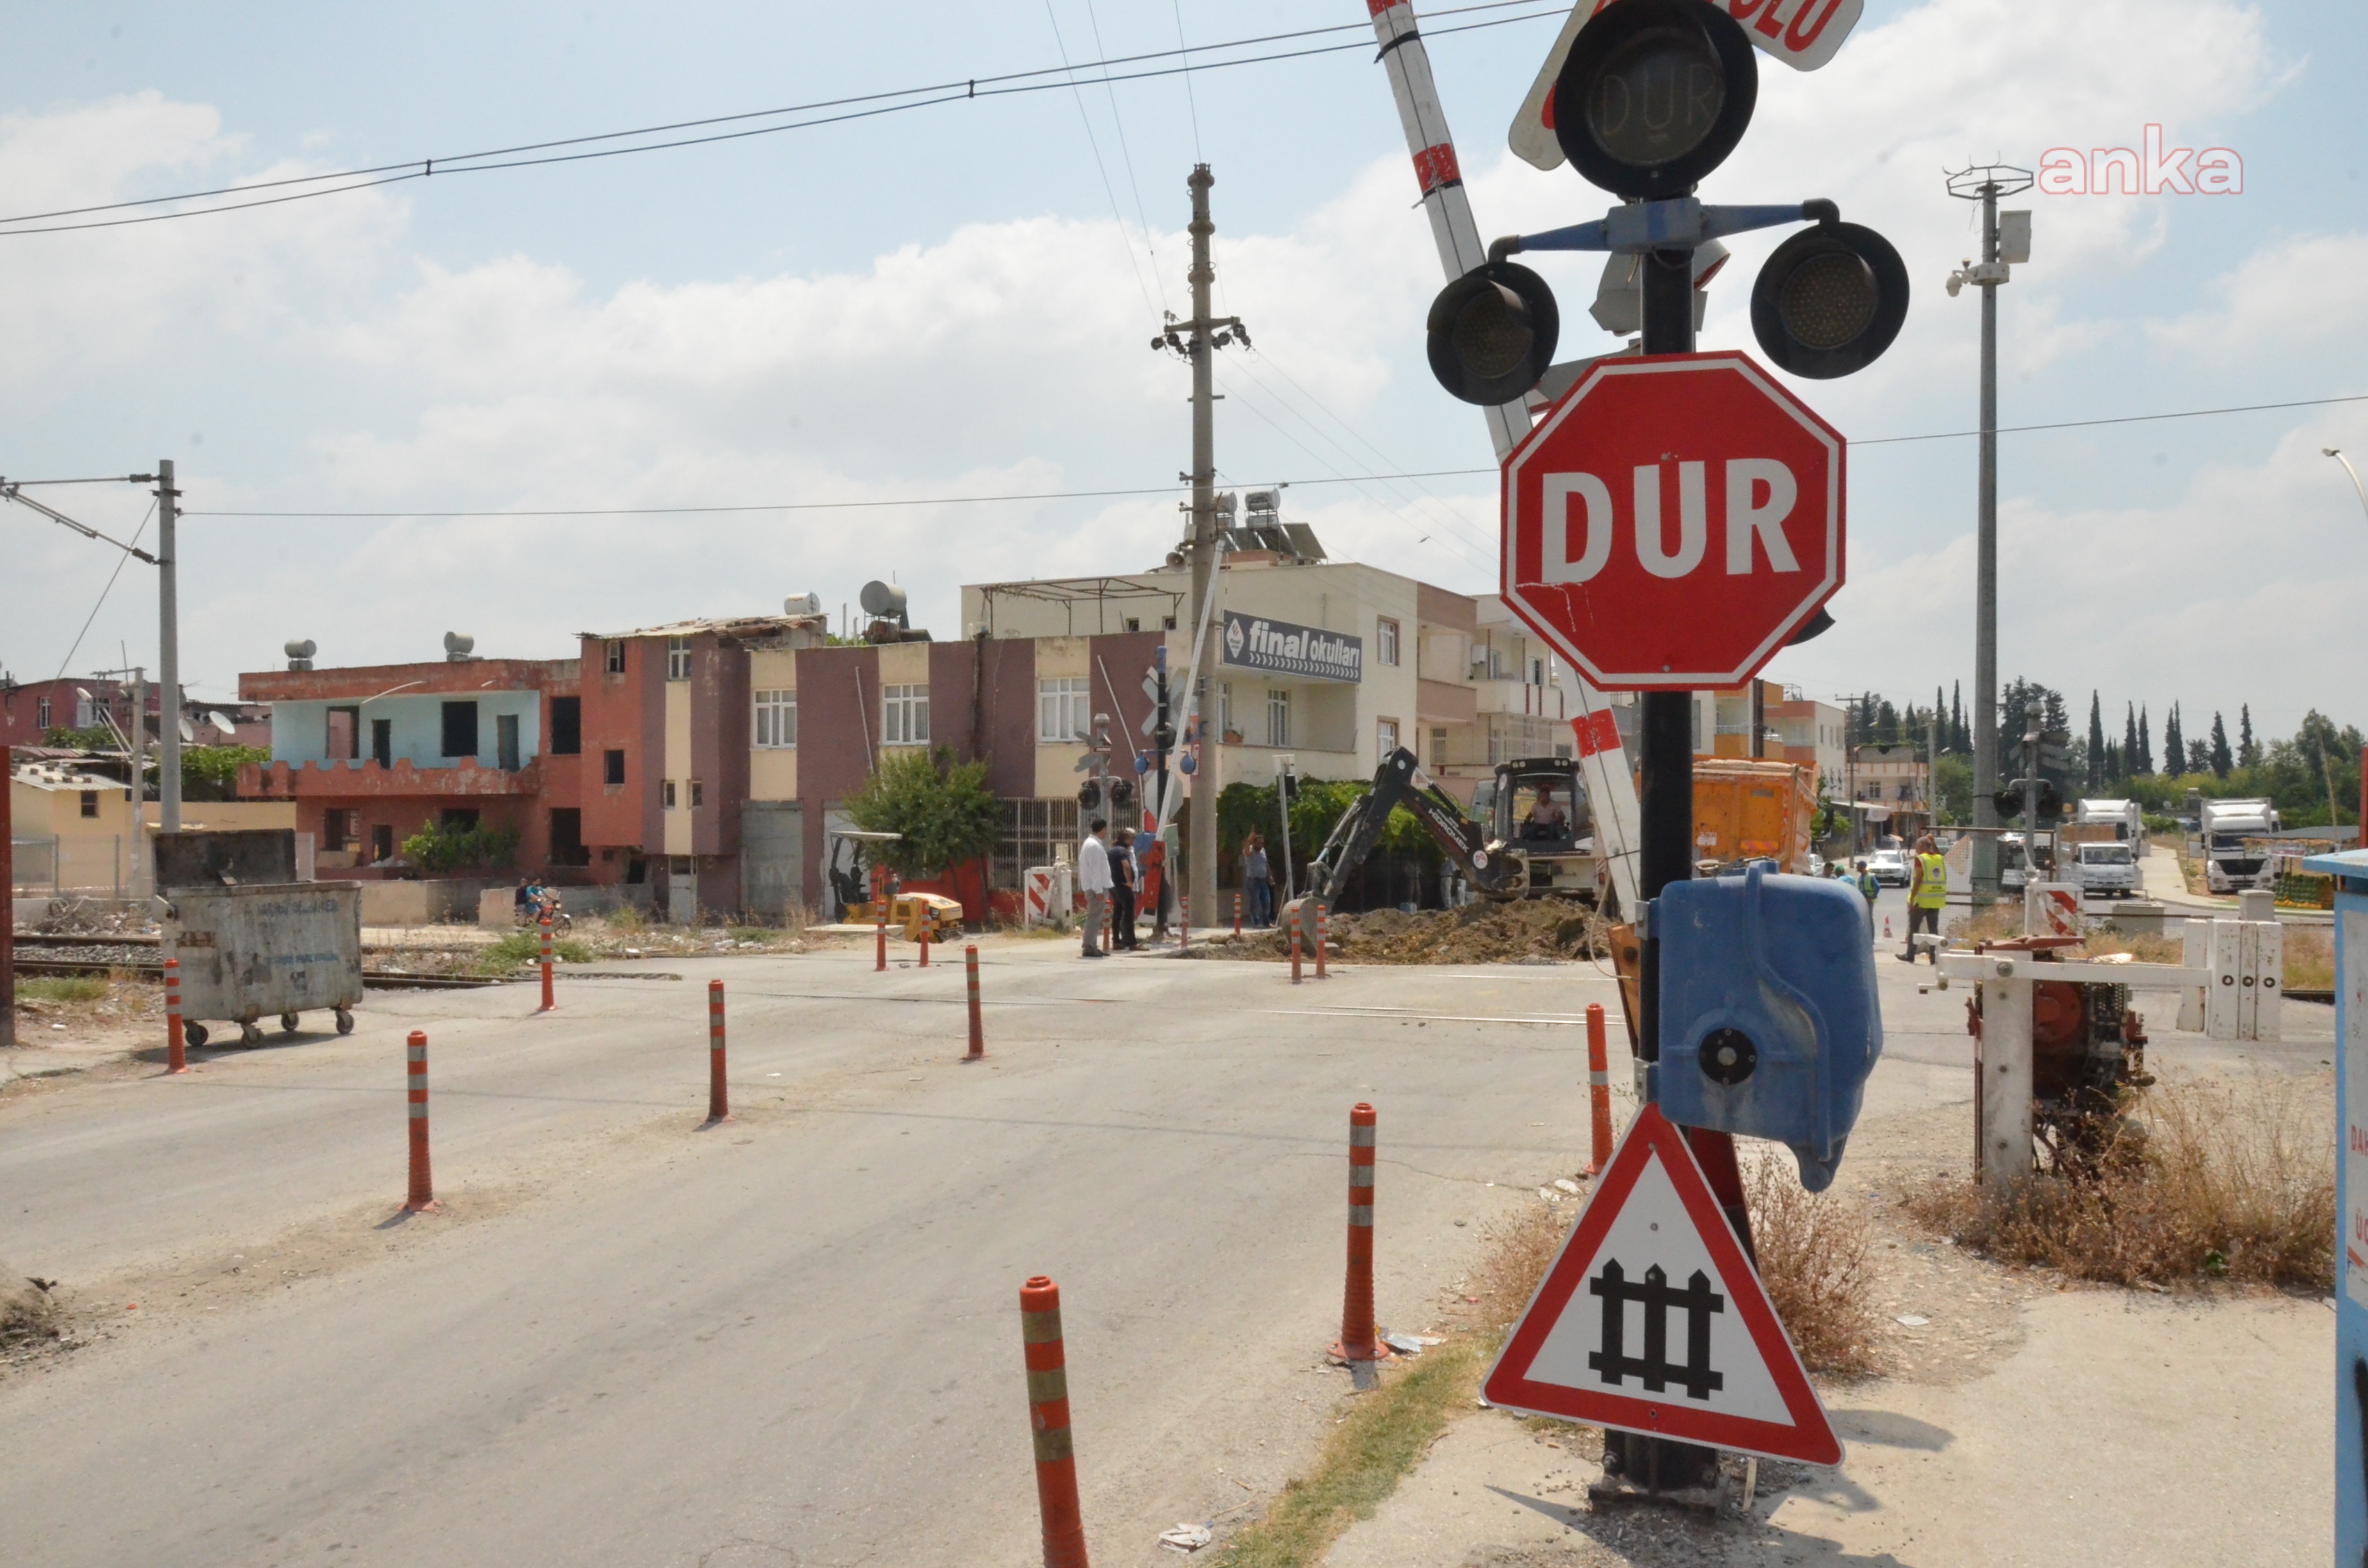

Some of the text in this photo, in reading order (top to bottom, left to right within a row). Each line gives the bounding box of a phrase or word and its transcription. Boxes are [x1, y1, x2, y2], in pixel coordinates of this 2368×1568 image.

[1602, 63, 1718, 135] DUR
[1541, 457, 1801, 584] DUR
[1249, 620, 1360, 668] final okulları
